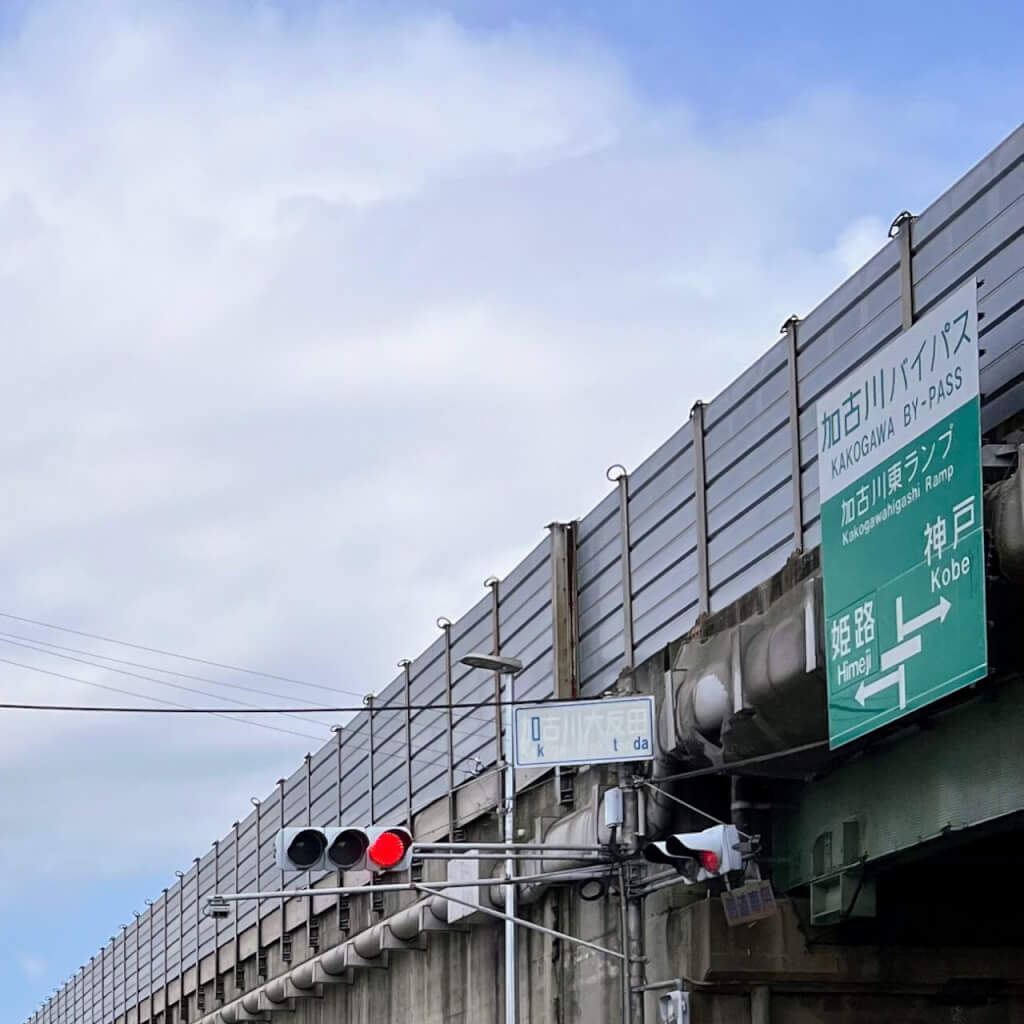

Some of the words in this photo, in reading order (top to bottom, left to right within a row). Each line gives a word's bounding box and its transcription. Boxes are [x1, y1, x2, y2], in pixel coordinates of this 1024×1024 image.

[822, 310, 971, 452] 加古川バイパス
[831, 417, 895, 478] KAKOGAWA
[903, 366, 962, 428] BY-PASS
[841, 423, 953, 527] 加古川東ランプ
[842, 483, 921, 546] Kakogawahigashi
[926, 465, 954, 492] Ramp
[924, 496, 975, 567] 神戸
[931, 556, 970, 593] Kobe
[831, 600, 875, 660] 姫路
[837, 649, 872, 686] Himeji
